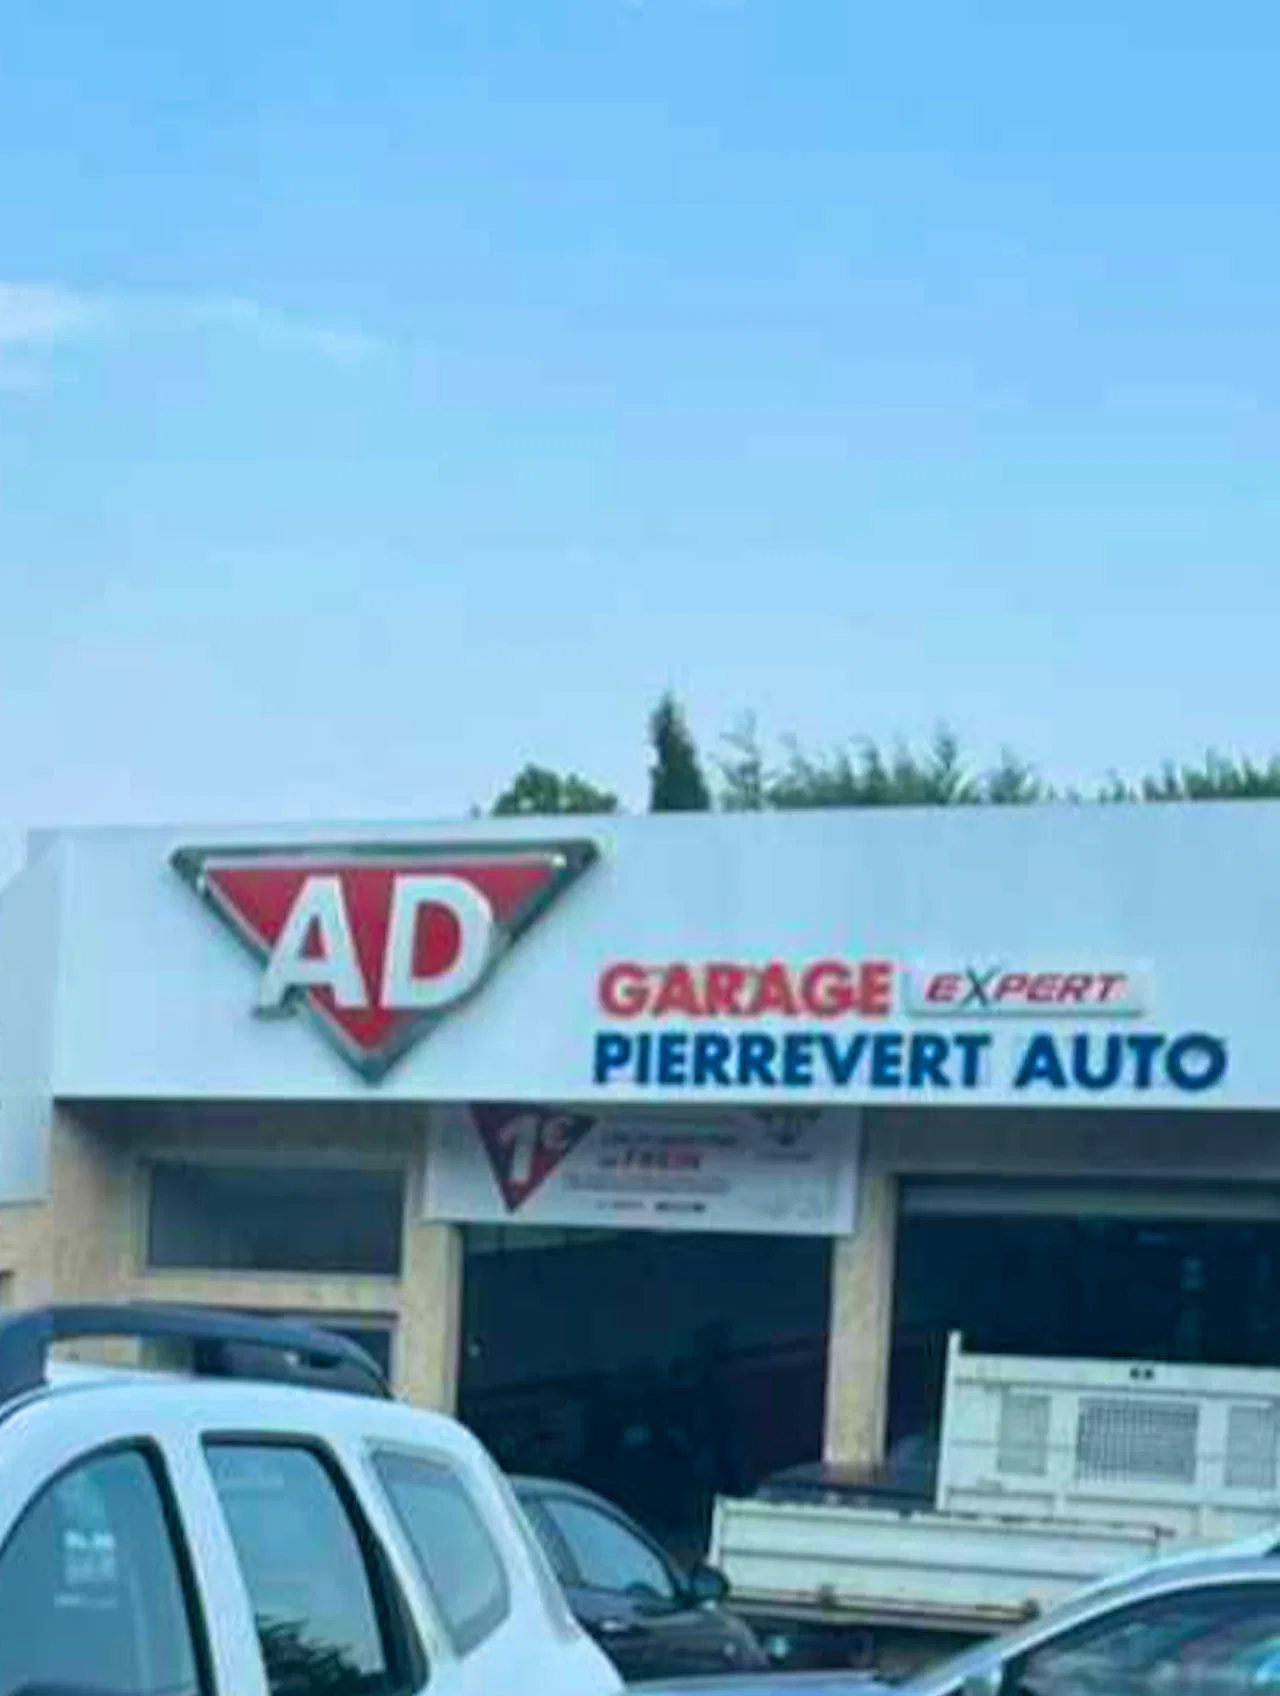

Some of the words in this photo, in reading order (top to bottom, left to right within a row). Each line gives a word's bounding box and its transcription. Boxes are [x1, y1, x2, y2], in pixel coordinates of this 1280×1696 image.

[262, 873, 495, 1010] AD
[598, 961, 892, 1018] GARAGE
[593, 1033, 991, 1089] PIERREVERT
[1013, 1030, 1229, 1092] AUTO
